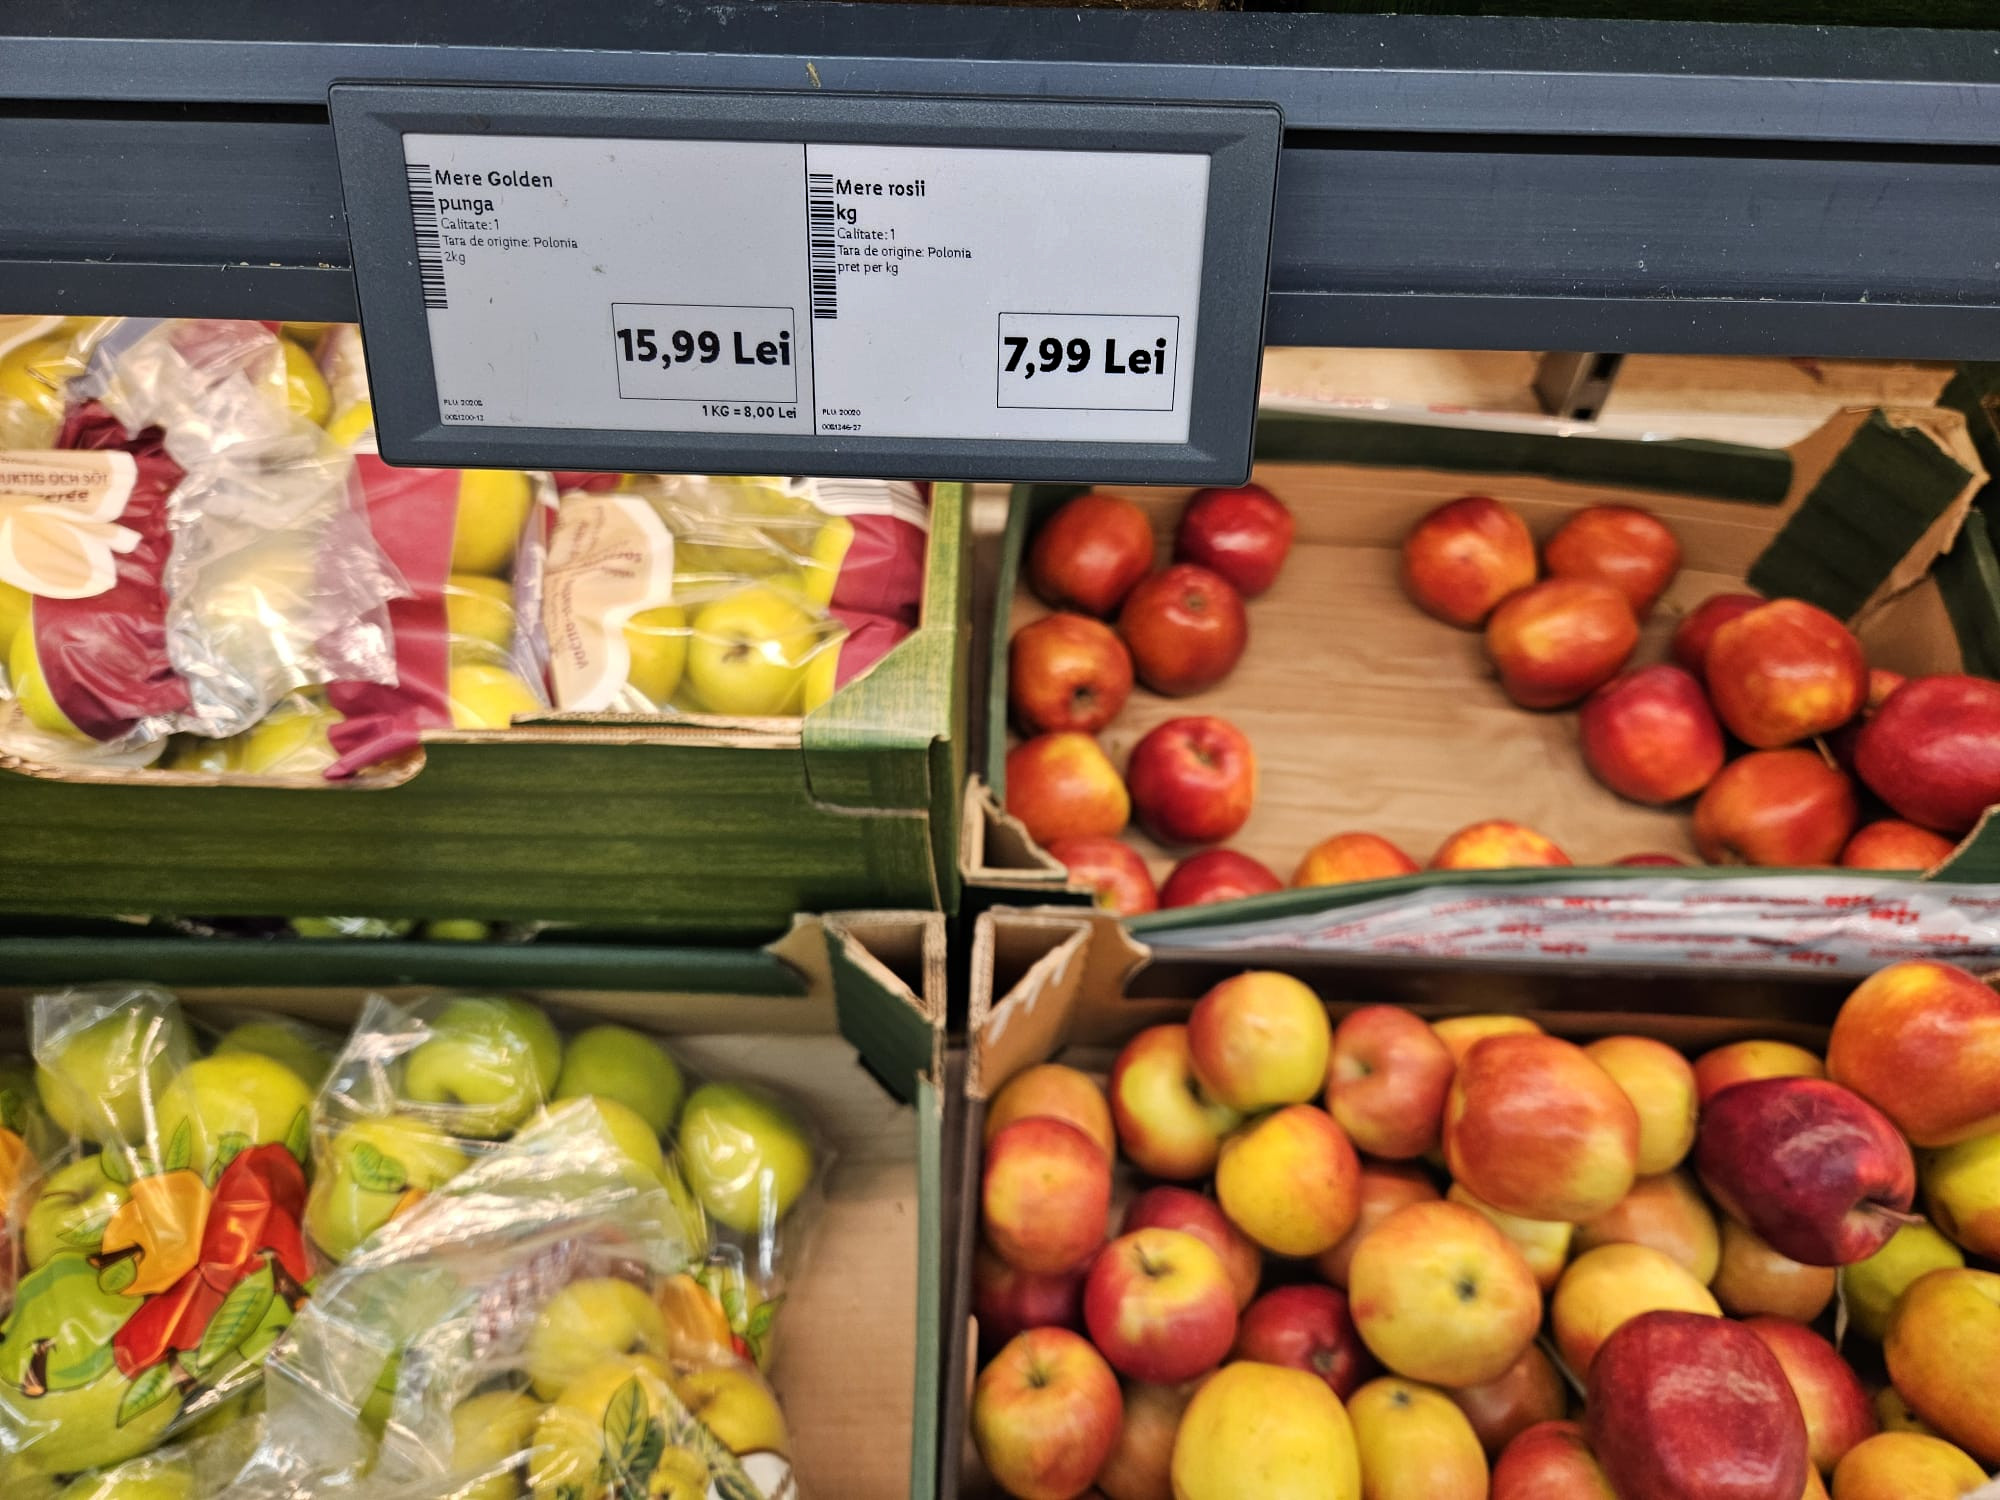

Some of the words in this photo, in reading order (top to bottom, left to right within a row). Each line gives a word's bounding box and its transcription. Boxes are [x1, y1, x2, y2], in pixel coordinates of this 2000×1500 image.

[434, 169, 483, 187] Mere
[487, 170, 553, 188] Golden
[836, 179, 883, 196] Mere
[888, 179, 925, 197] rosii
[438, 198, 495, 215] punga
[836, 203, 857, 224] kg
[442, 234, 467, 247] Tara
[469, 235, 484, 247] de
[487, 235, 531, 251] origine:
[533, 236, 579, 249] Polonia
[444, 250, 466, 265] 2kg
[837, 244, 861, 257] Tara
[864, 245, 879, 257] de
[881, 246, 924, 261] origine:
[927, 246, 973, 259] Polonia
[837, 262, 860, 275] pret
[864, 263, 883, 276] per
[886, 261, 899, 276] kg
[616, 328, 721, 370] 15,99
[733, 330, 791, 366] Lei
[1003, 336, 1091, 379] 7,99
[1104, 337, 1167, 375] Lei
[702, 404, 708, 417] 1
[711, 405, 730, 418] KG
[743, 405, 775, 420] 8,00
[778, 406, 797, 419] Lei
